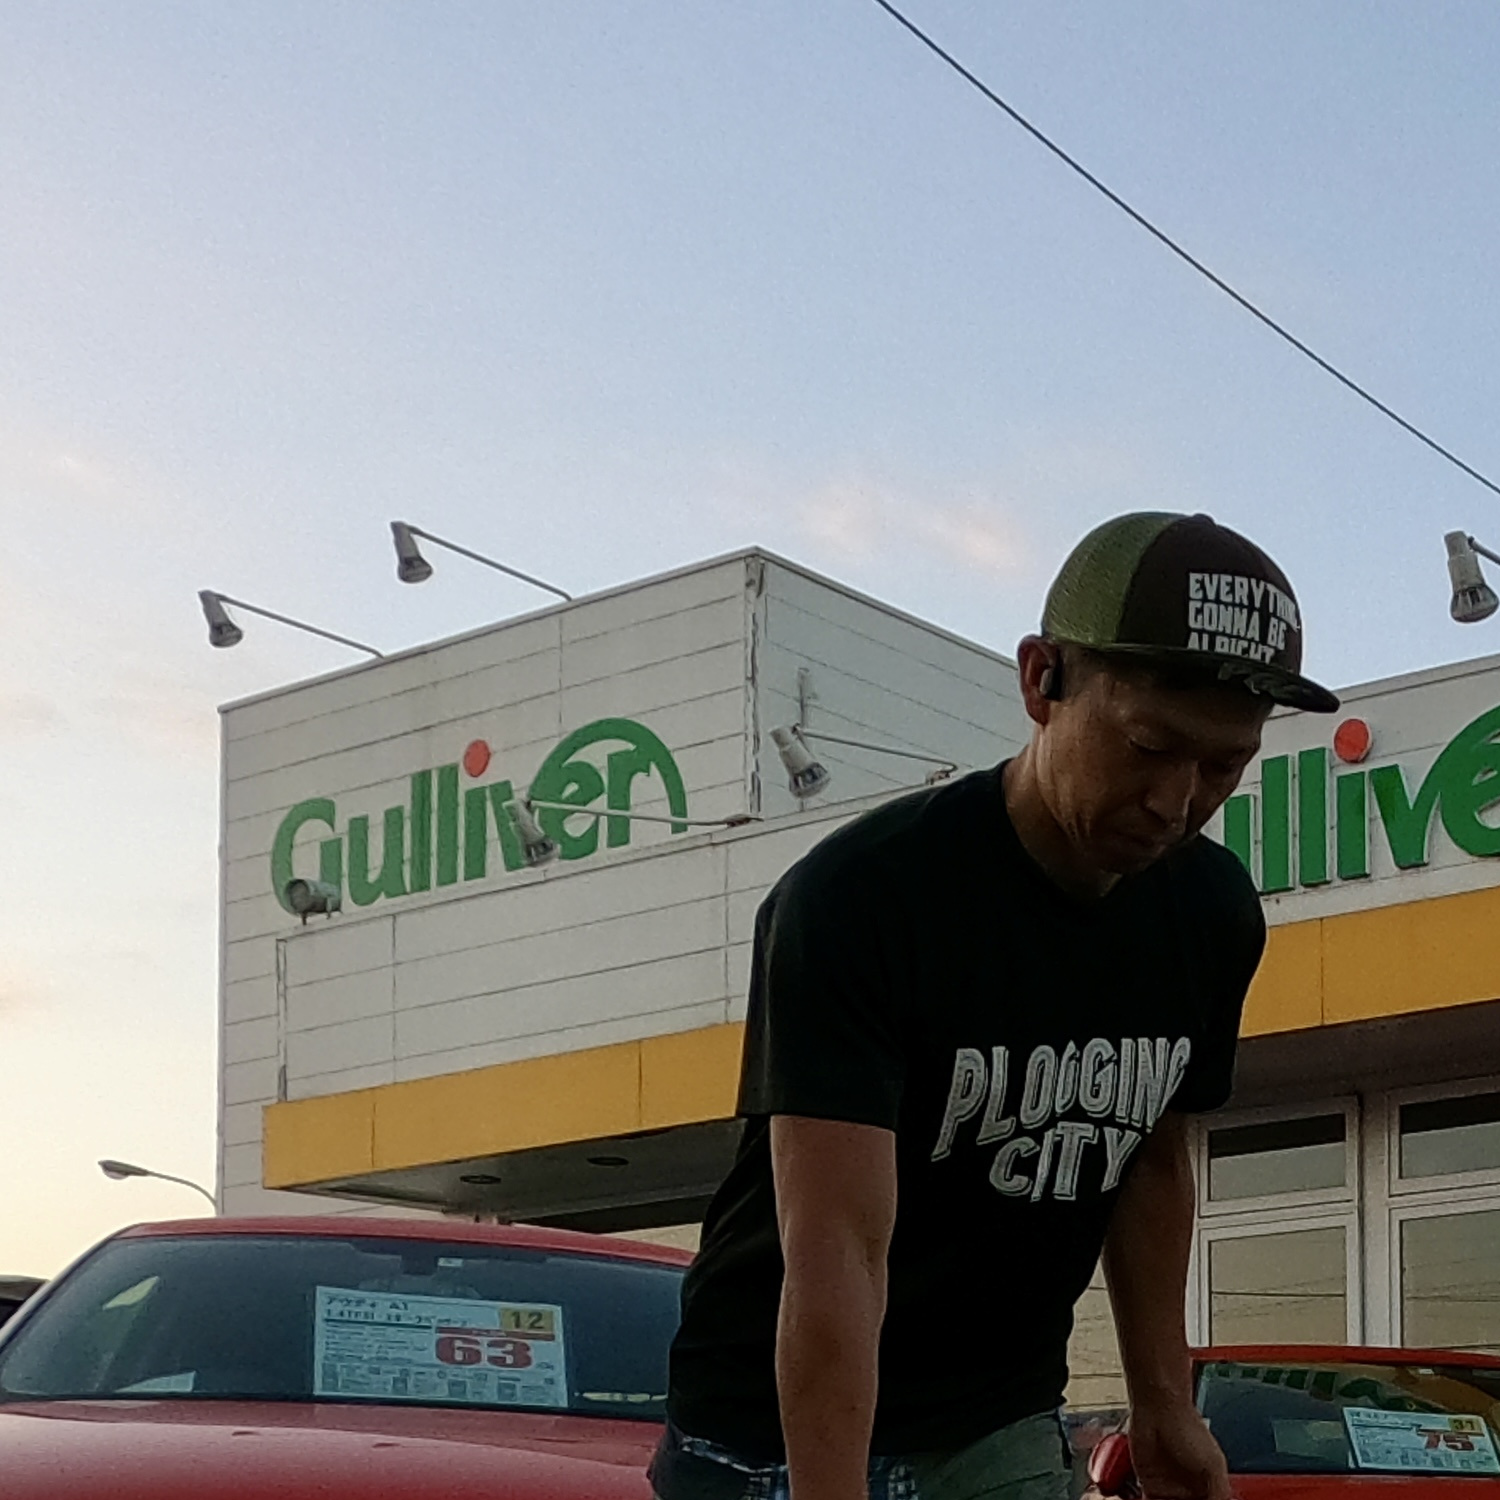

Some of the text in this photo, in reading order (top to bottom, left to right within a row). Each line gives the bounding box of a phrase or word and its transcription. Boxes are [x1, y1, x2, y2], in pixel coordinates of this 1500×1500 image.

[1188, 600, 1287, 650] GONNA BE
[988, 1121, 1142, 1203] CITY
[510, 1310, 545, 1330] 12
[435, 1335, 533, 1369] 63
